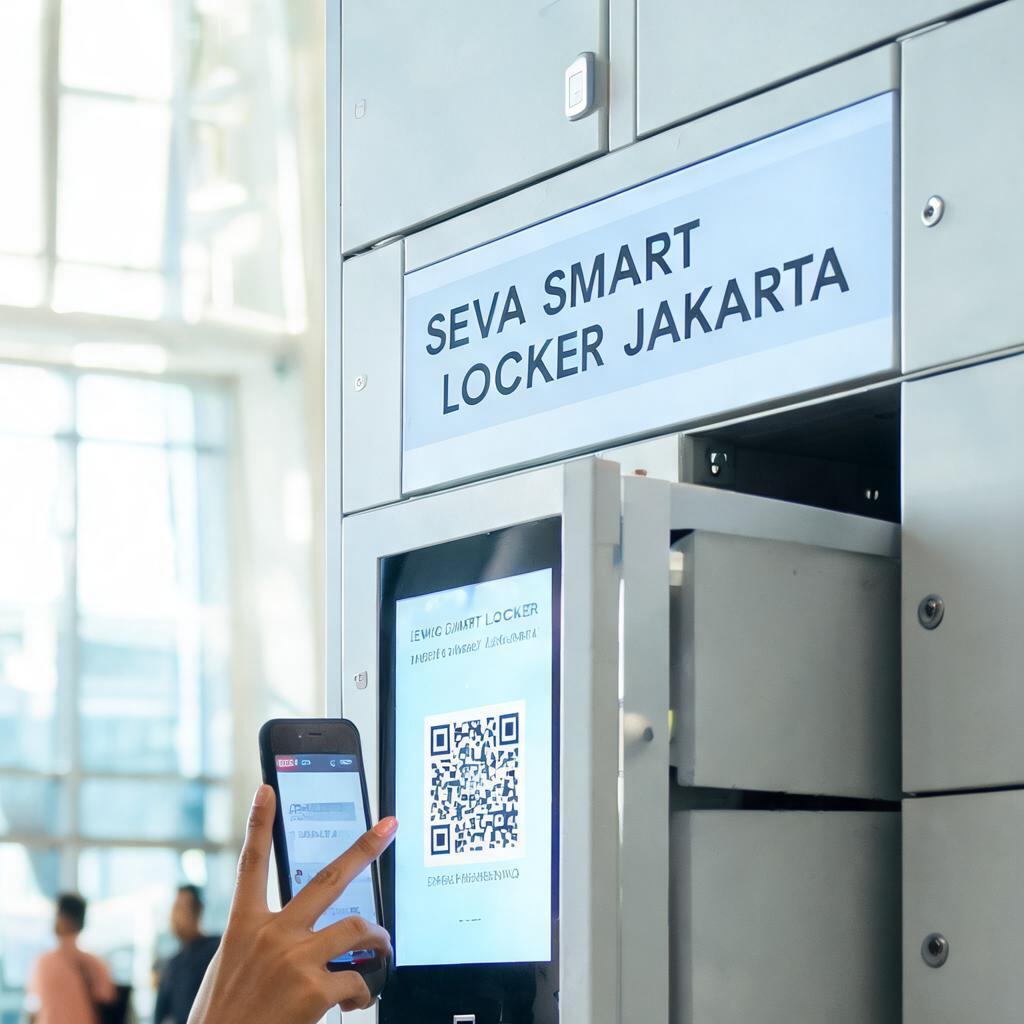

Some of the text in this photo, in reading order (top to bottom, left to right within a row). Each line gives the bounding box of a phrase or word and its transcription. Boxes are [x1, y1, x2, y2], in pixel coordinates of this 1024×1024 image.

[425, 218, 701, 356] SEVA SMART
[442, 246, 850, 415] LOCKER JAKARTA
[485, 602, 539, 626] LOCKER
